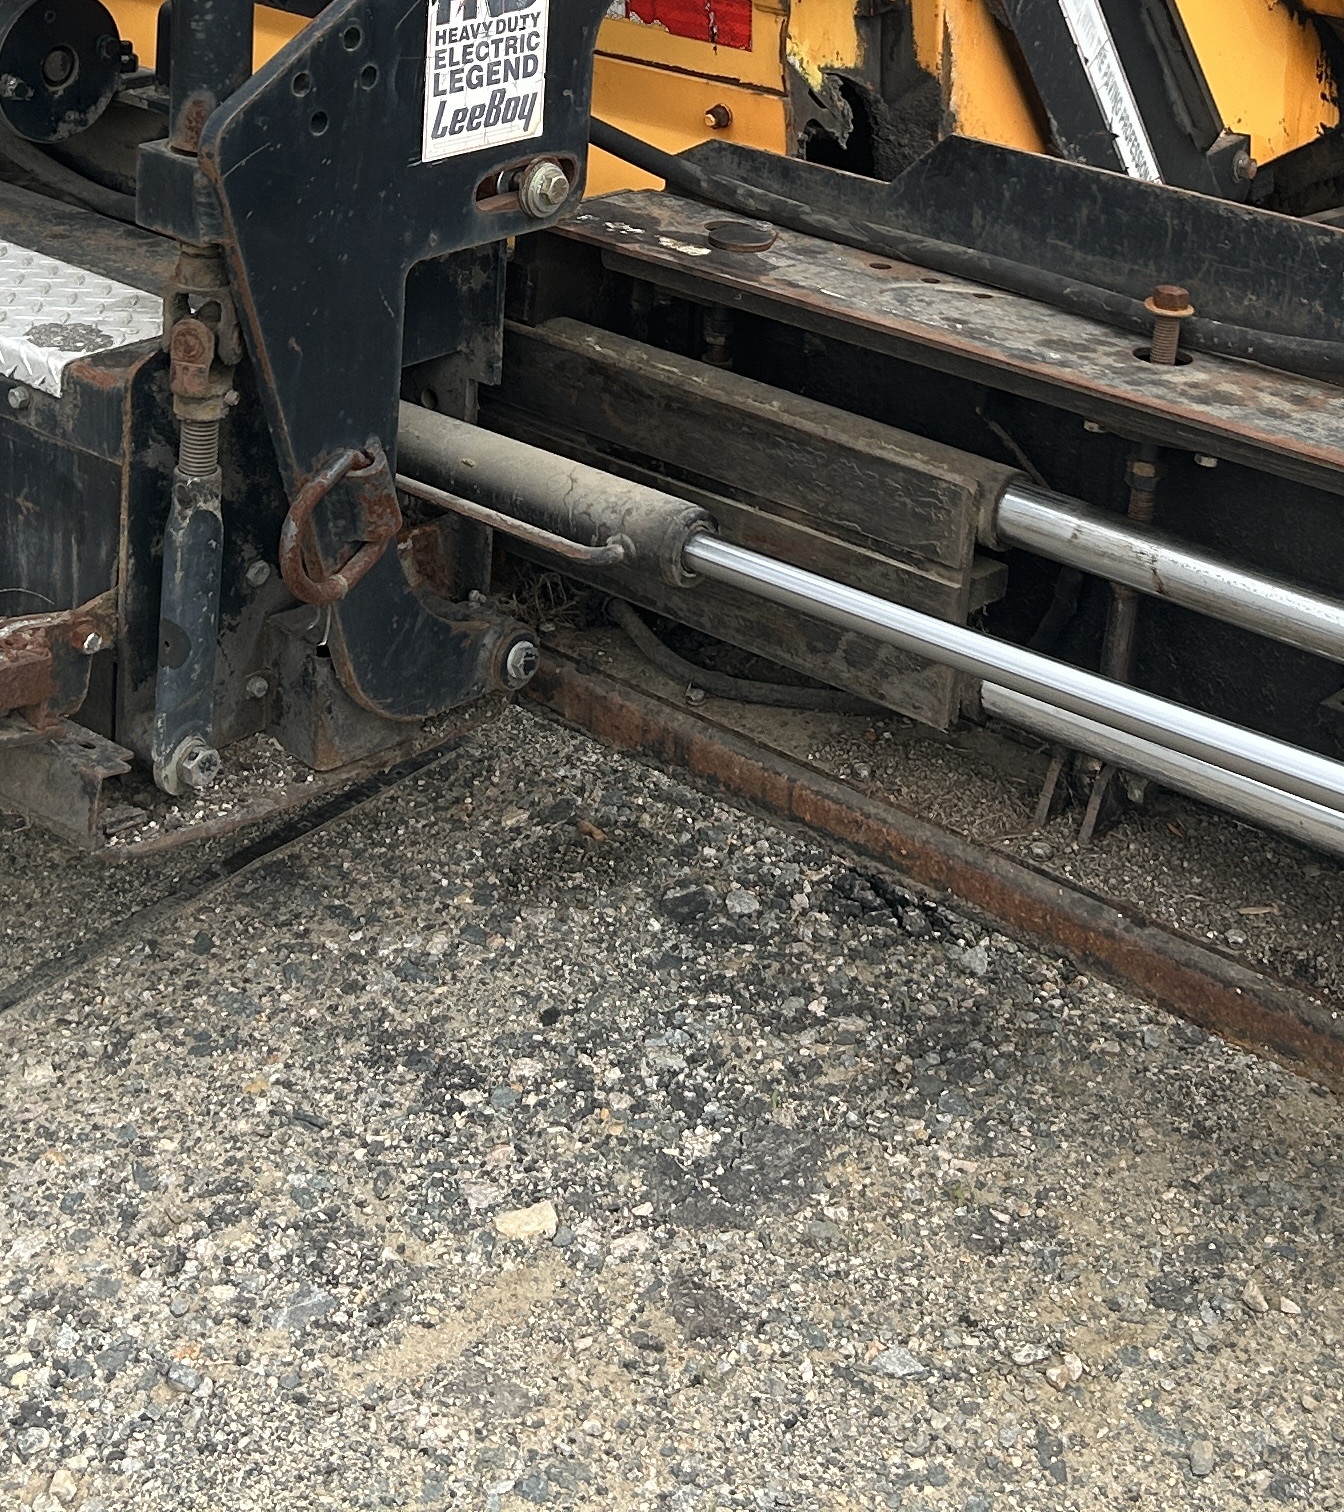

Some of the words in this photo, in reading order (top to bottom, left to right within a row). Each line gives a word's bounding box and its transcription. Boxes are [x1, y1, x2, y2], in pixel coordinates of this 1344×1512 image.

[435, 21, 493, 46] HEAVY
[496, 11, 542, 36] DUTY
[434, 31, 541, 71] ELECTRIC
[432, 54, 539, 97] LEGEND
[431, 87, 538, 140] LeeBoy
